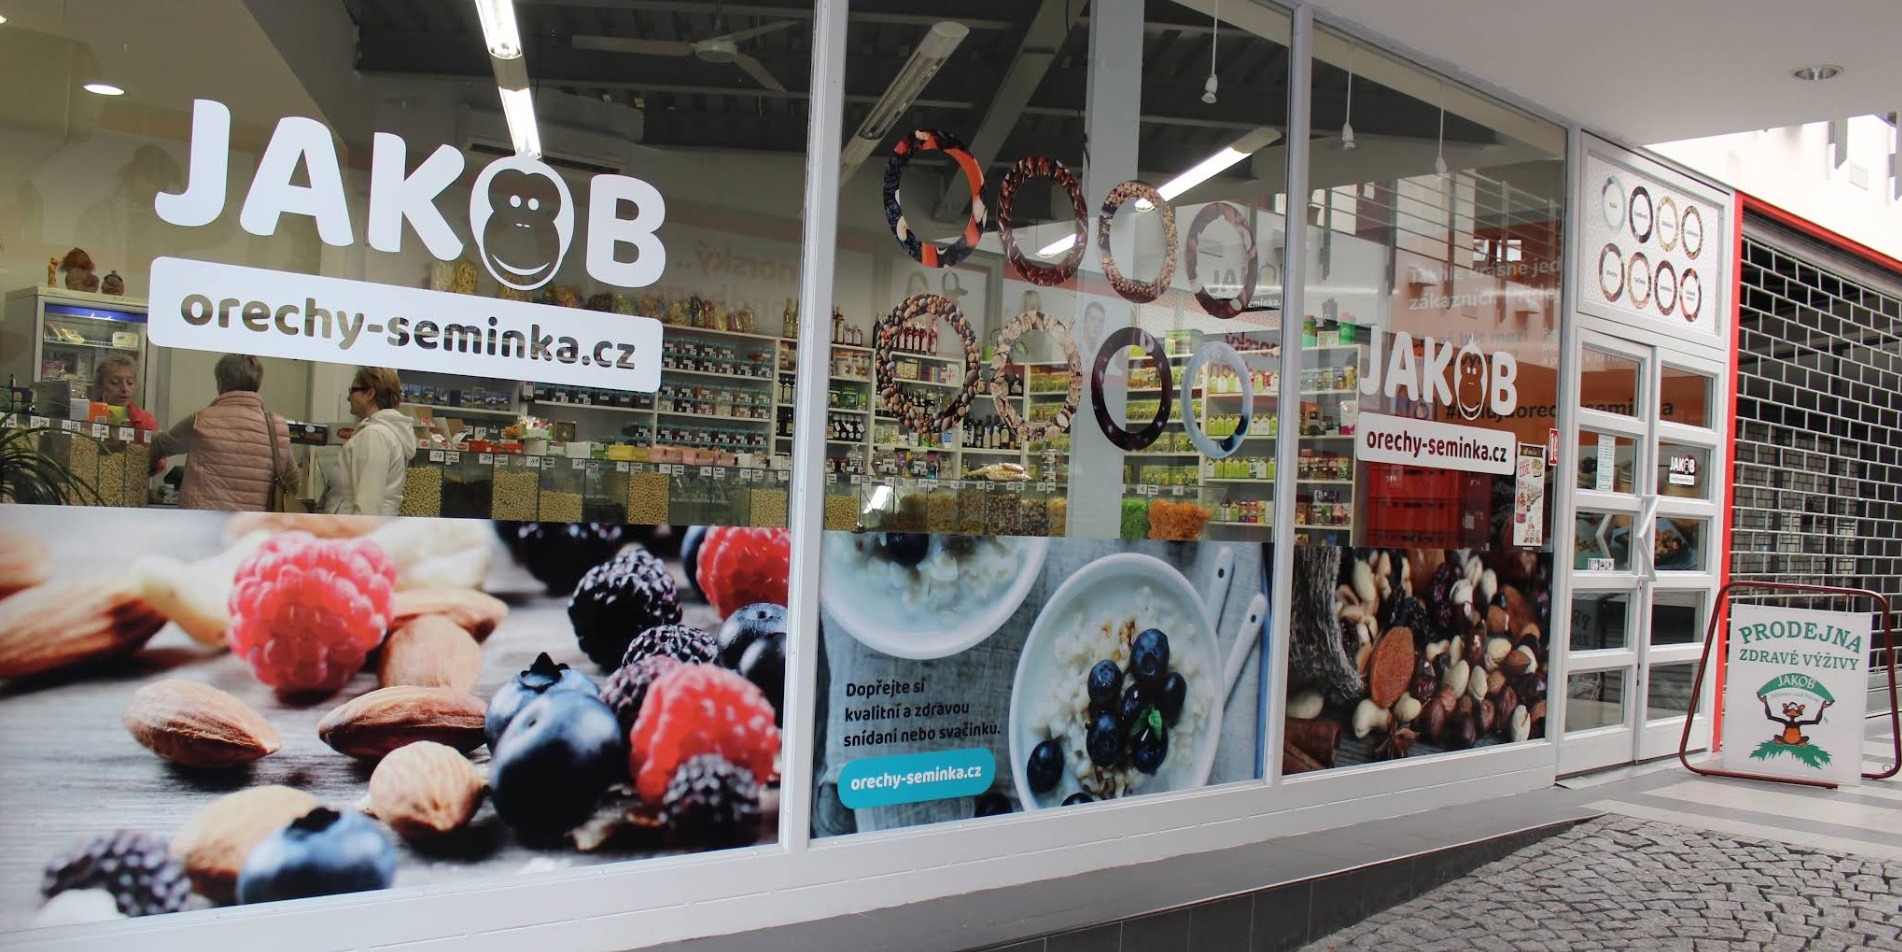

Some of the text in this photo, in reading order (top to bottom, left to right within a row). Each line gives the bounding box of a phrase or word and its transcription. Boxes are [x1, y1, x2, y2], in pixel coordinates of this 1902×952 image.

[155, 98, 667, 290] JAKOB
[180, 290, 637, 372] orechy-seminka.cz
[1360, 325, 1517, 420] JAKOB
[1366, 430, 1508, 463] orechy-seminka.cz
[1670, 456, 1695, 474] JAKOB
[1738, 620, 1862, 654] PRODEJNA
[1739, 648, 1860, 671] ZDRAVÉ VÝŽIVY
[846, 678, 925, 698] Dopřejte si
[1778, 674, 1816, 690] JAKOB
[845, 702, 970, 722] kvalitní a zdravou
[901, 727, 936, 743] nebo
[939, 721, 1001, 741] svačinku.
[850, 765, 982, 790] orechy-seminka.cz
